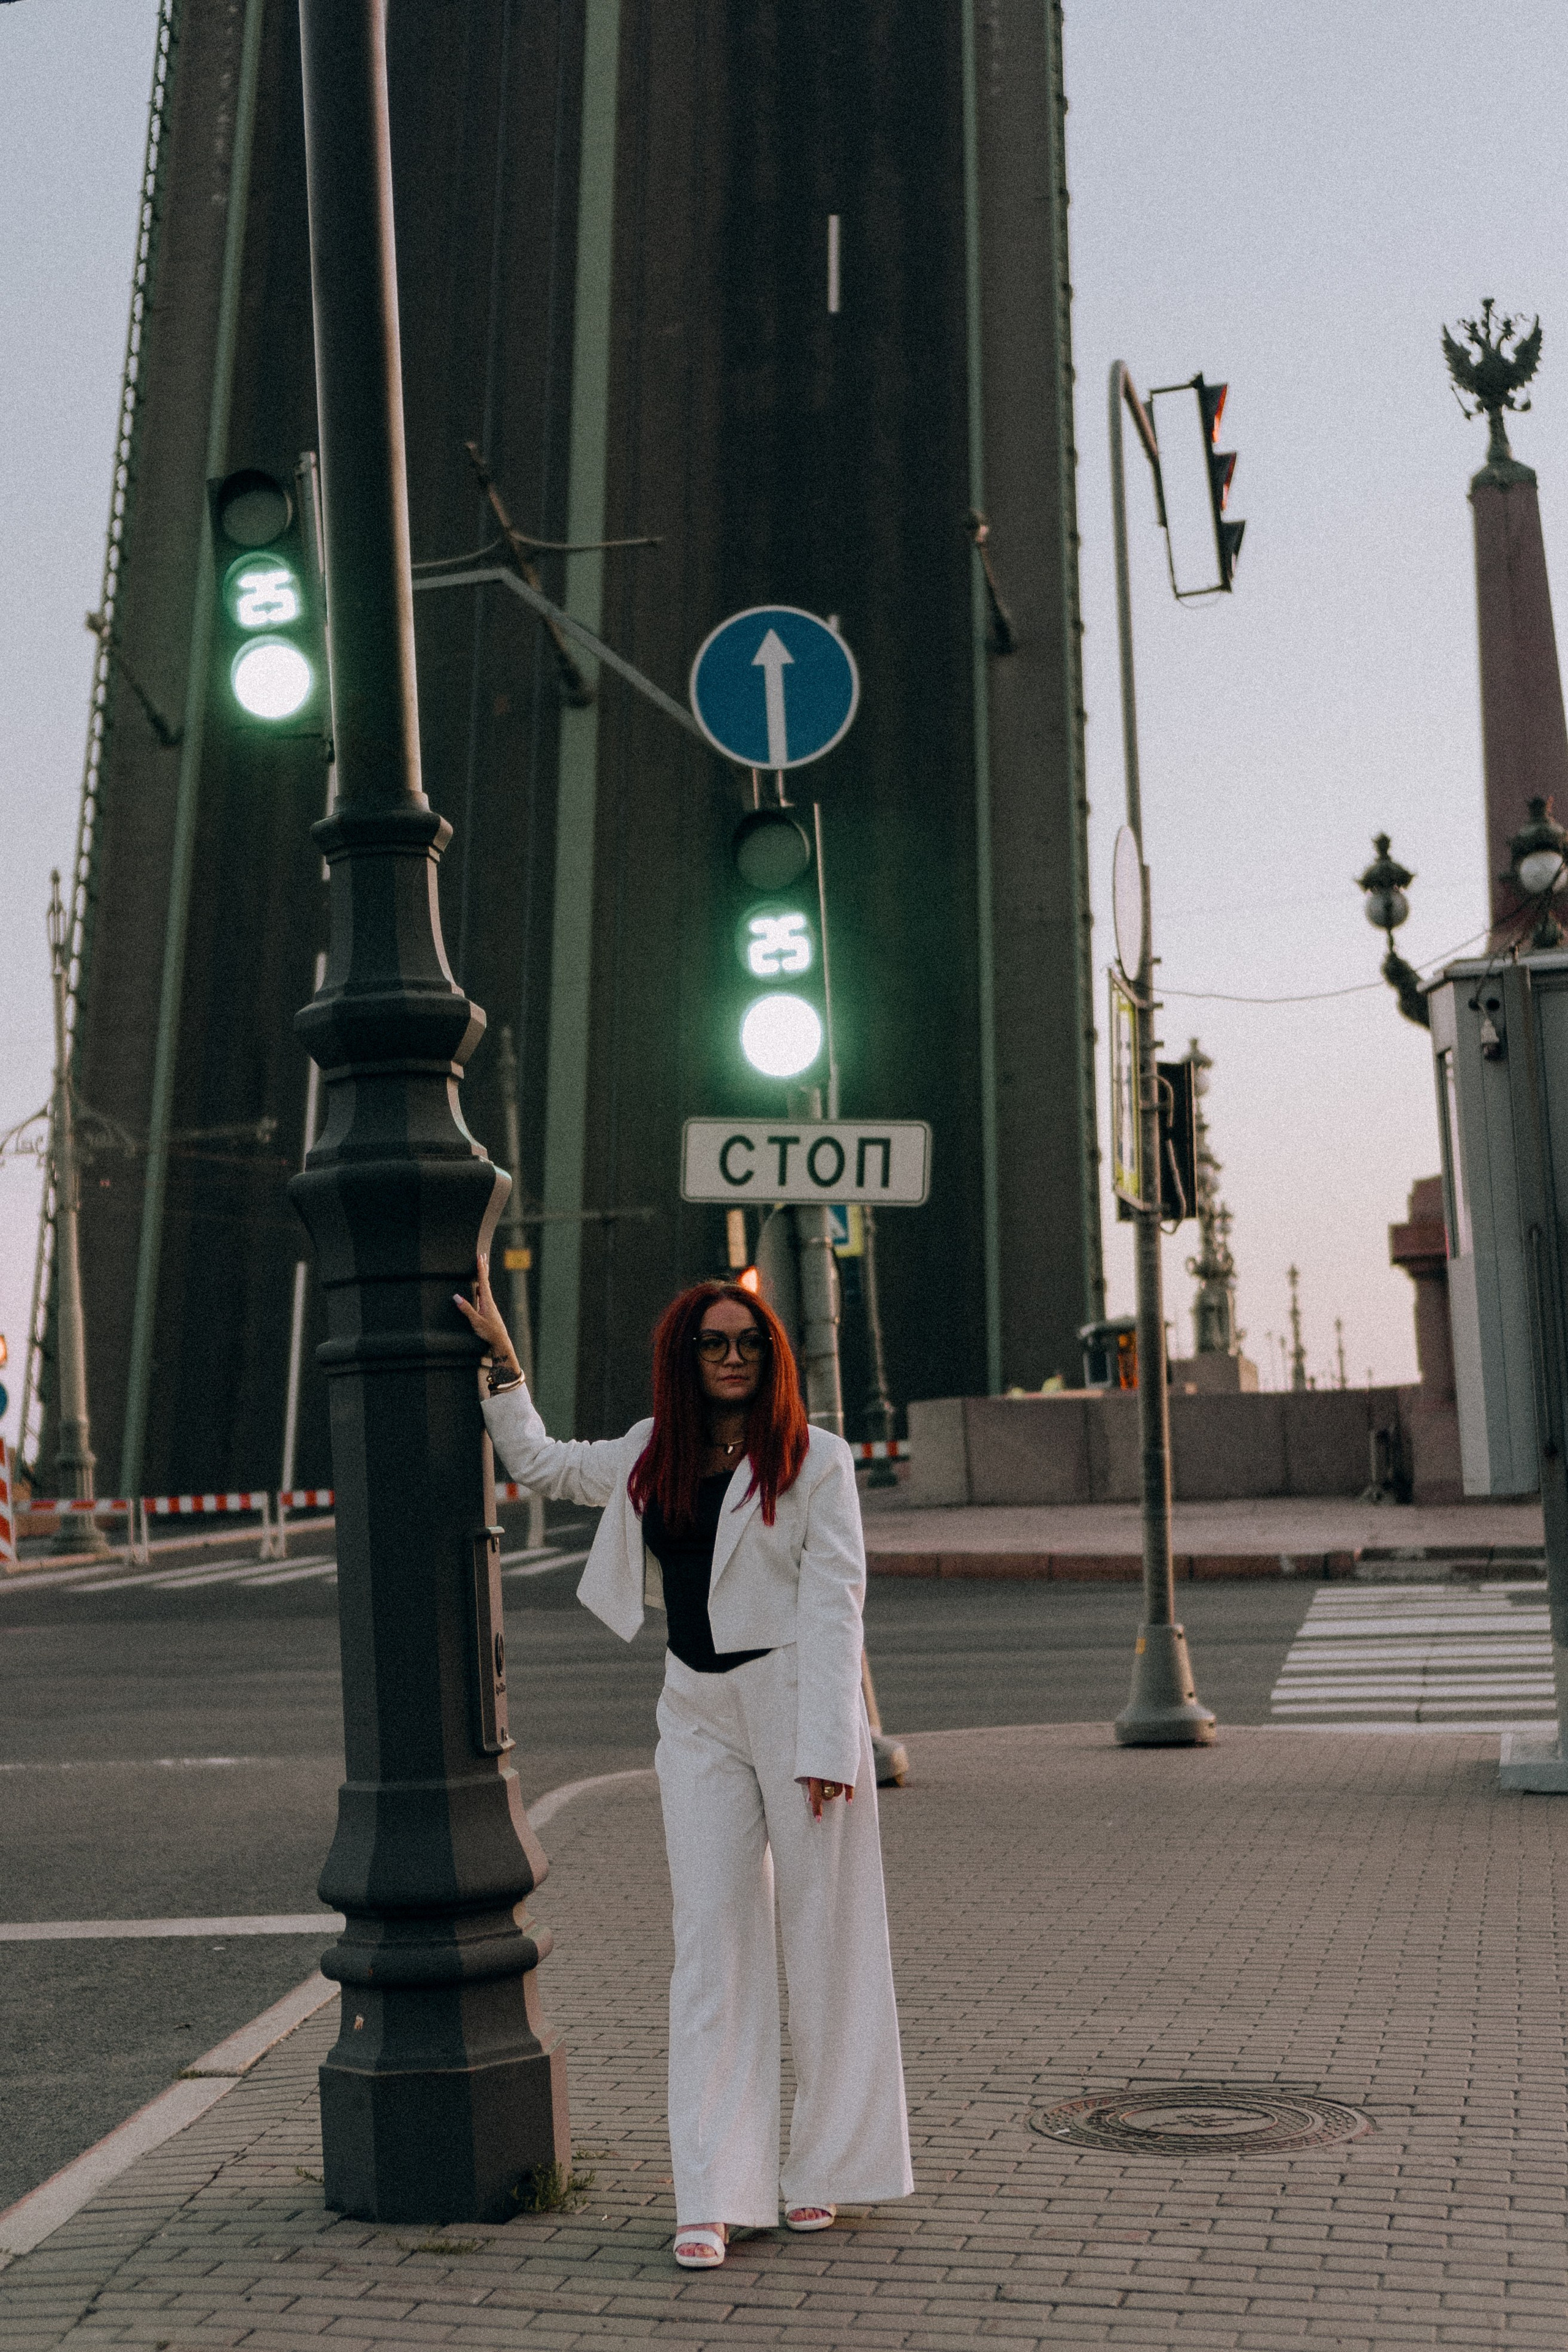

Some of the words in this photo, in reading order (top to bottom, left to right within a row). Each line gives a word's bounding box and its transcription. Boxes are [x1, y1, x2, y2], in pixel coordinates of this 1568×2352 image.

[236, 569, 299, 627] 25
[747, 913, 812, 975] 25
[719, 1135, 891, 1188] СТОП
